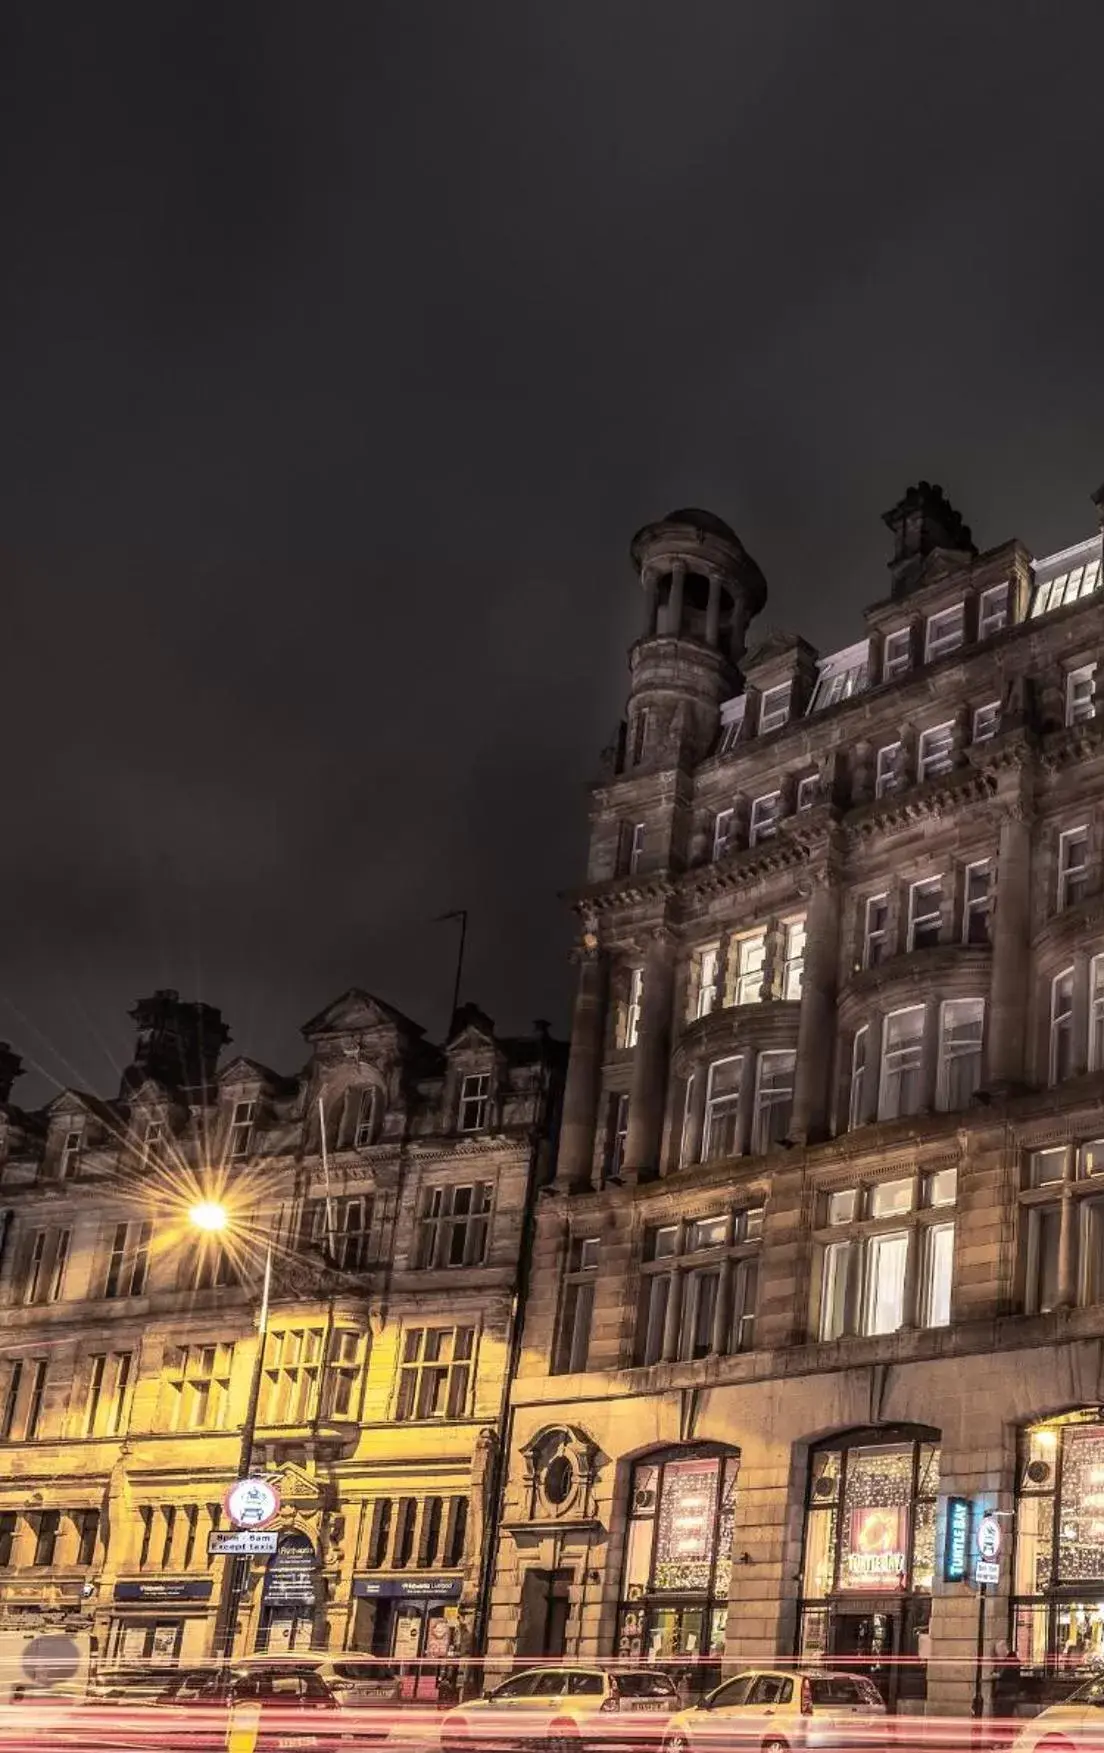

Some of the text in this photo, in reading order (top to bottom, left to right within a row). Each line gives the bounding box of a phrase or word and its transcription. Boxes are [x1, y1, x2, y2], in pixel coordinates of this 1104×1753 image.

[211, 1542, 246, 1551] Except
[949, 1503, 967, 1576] TURTLE BAY
